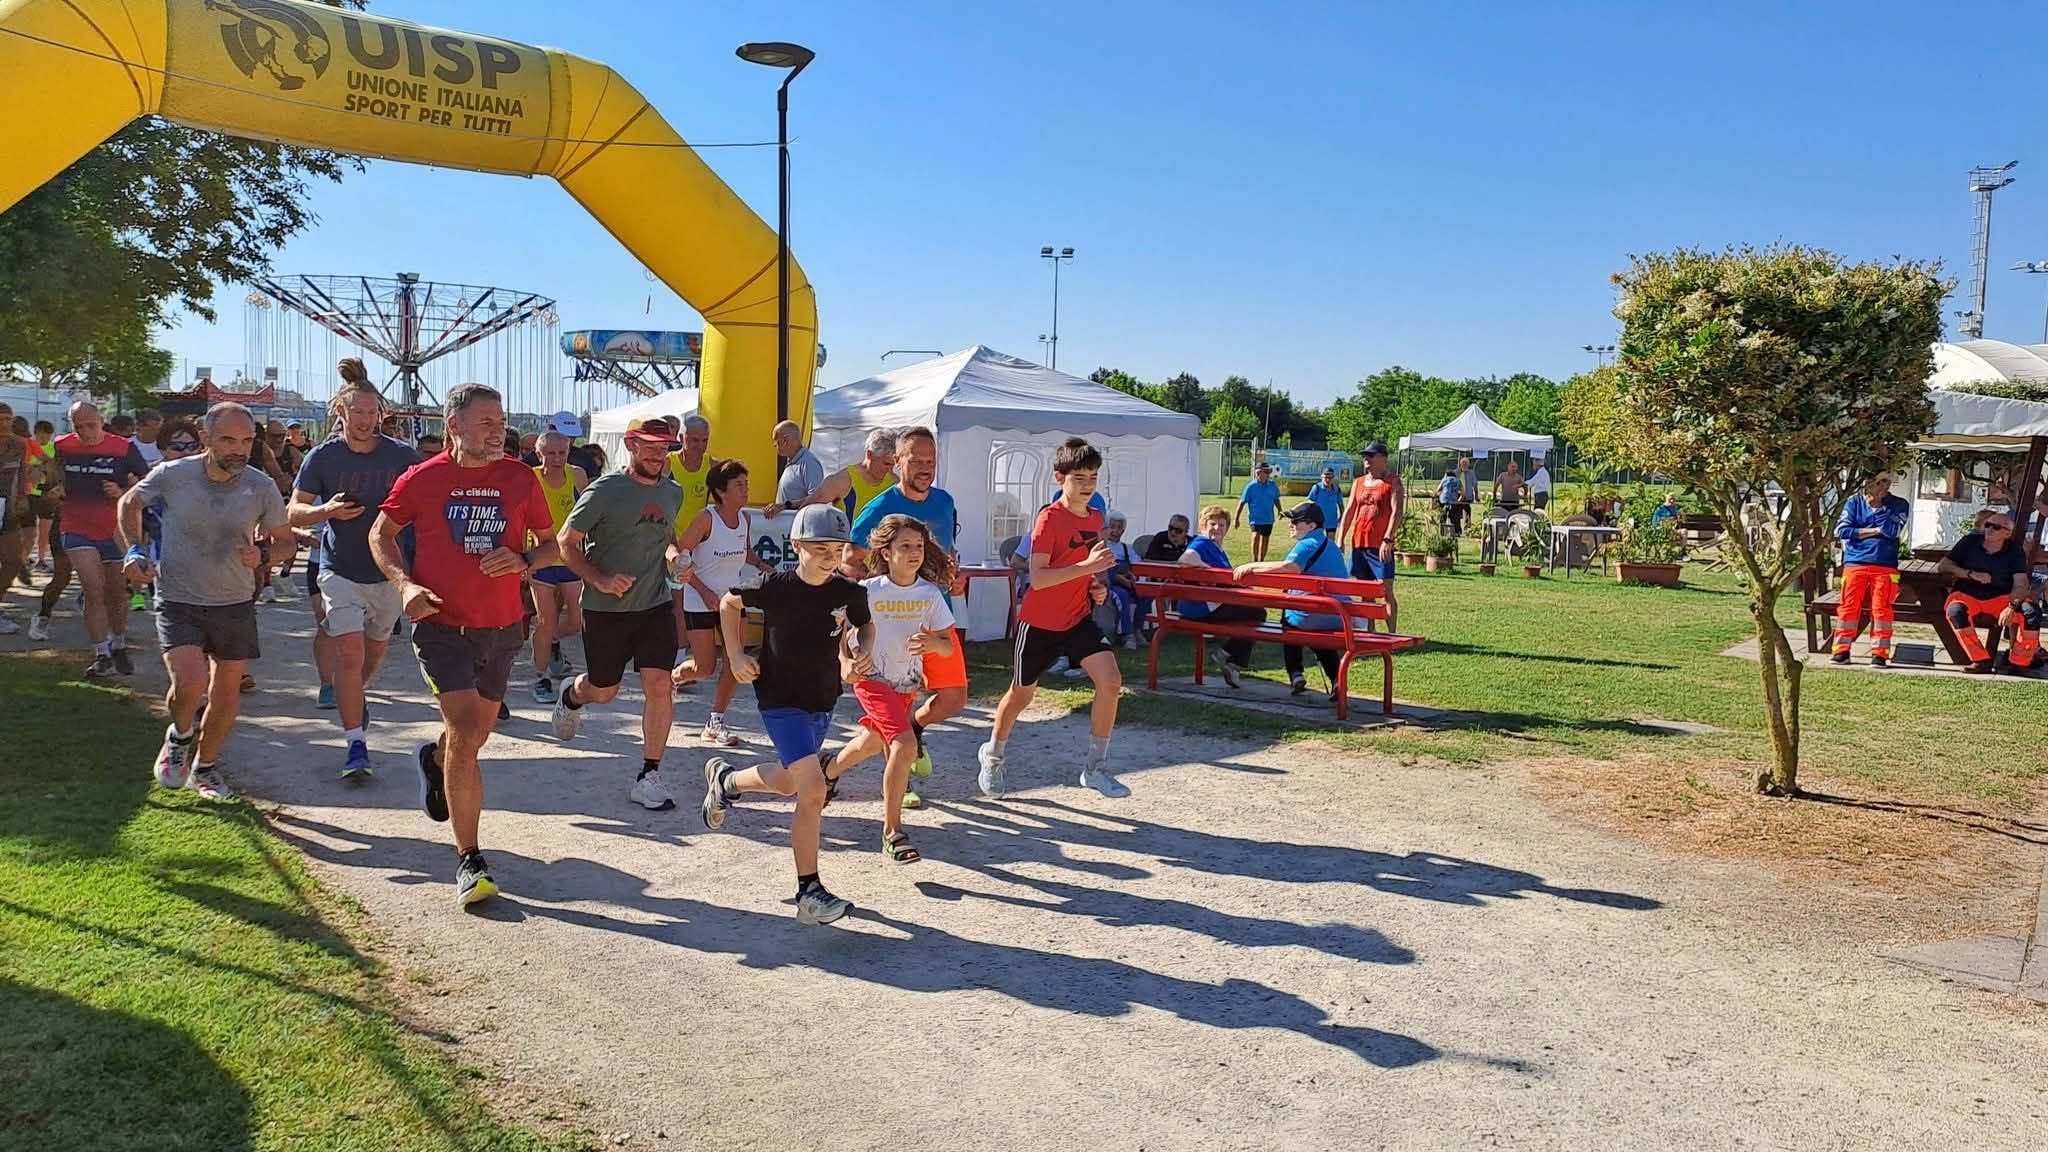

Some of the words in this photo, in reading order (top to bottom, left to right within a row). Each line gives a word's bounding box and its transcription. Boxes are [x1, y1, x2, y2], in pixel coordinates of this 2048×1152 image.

[341, 15, 521, 90] UISP
[344, 94, 411, 121] SPORT
[418, 107, 453, 127] PER
[463, 114, 512, 135] TUTTI
[346, 70, 428, 103] UNIONE
[437, 87, 524, 119] ITALIANA
[447, 505, 469, 519] IT'S
[471, 505, 498, 519] TIME
[467, 519, 481, 533] TO
[482, 520, 507, 533] RUN
